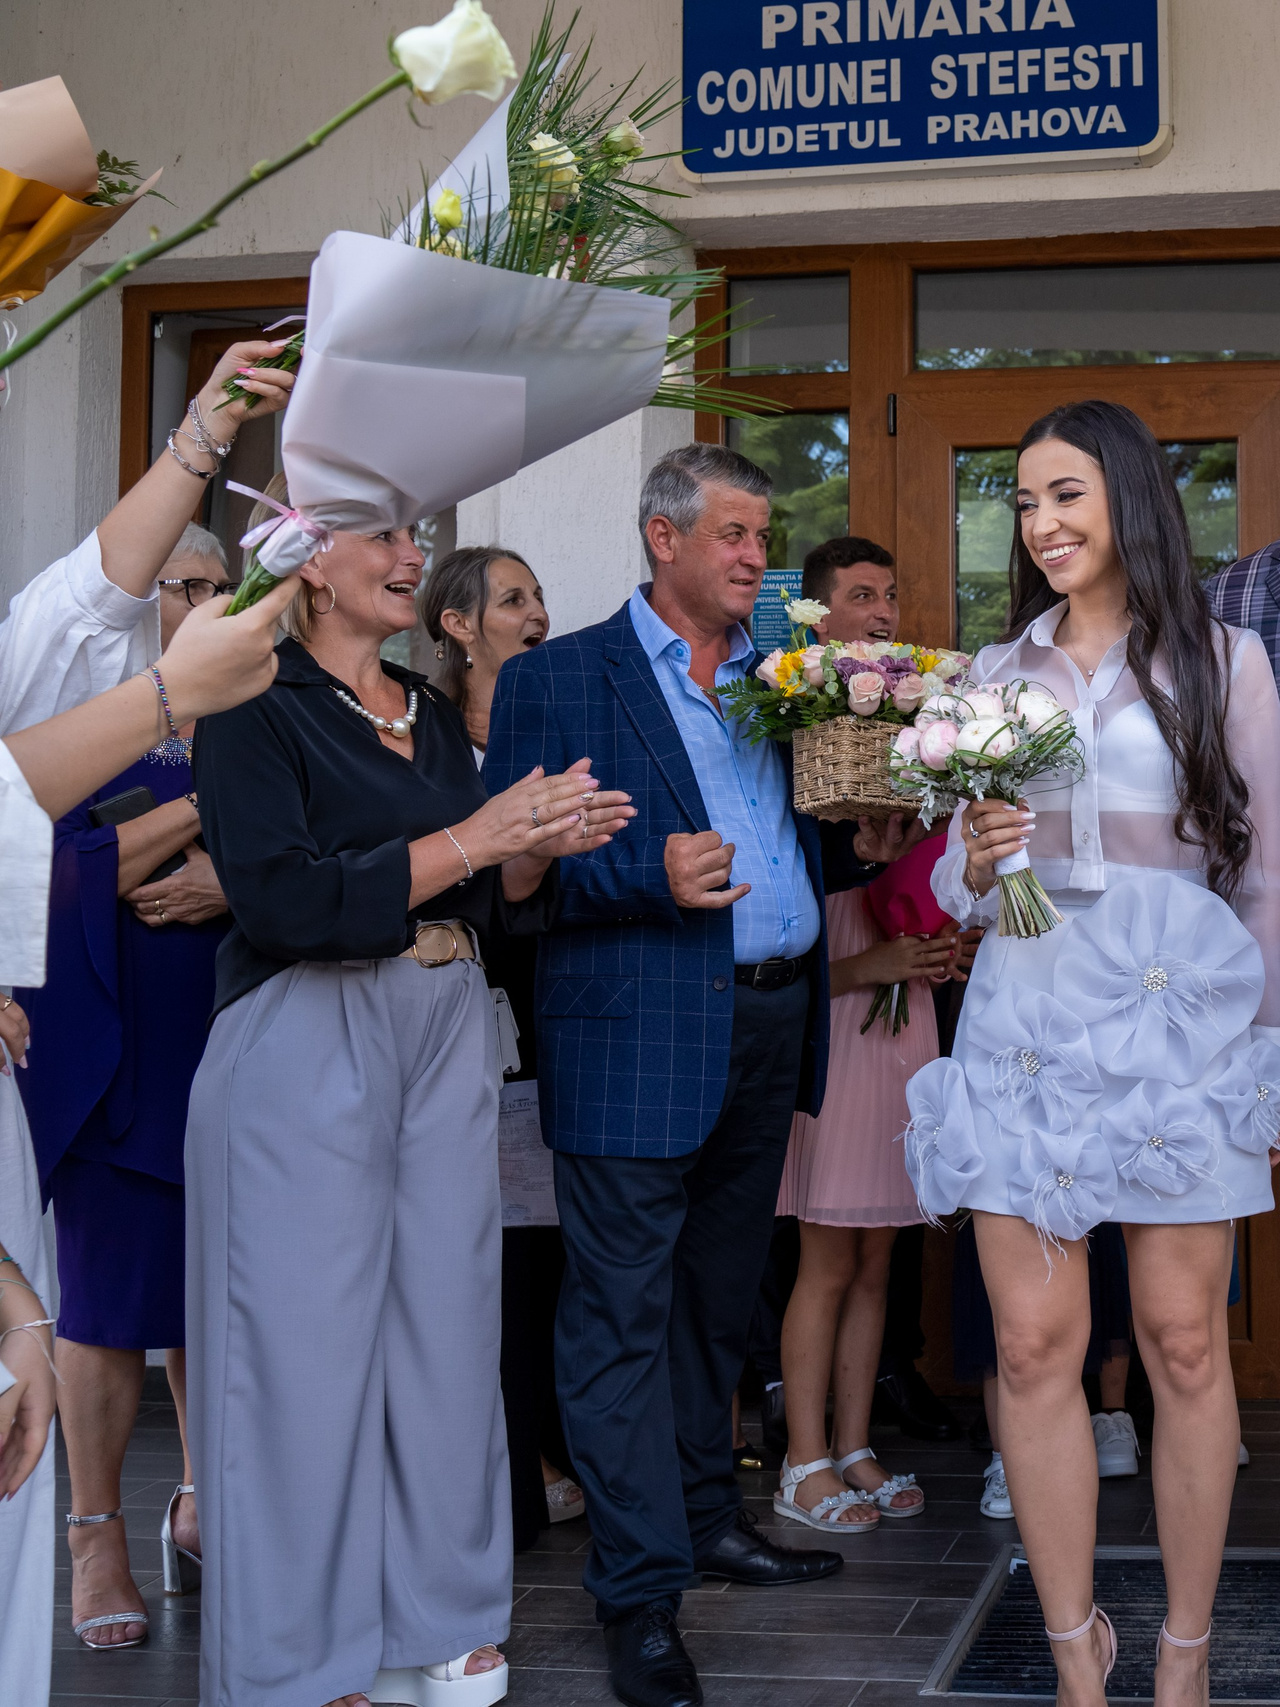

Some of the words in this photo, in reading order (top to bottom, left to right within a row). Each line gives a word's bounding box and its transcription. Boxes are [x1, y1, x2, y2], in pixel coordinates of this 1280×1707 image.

[762, 0, 1075, 49] PRIMARIA
[697, 58, 901, 115] COMUNEI
[930, 43, 1144, 99] STEFESTI
[712, 119, 901, 158] JUDETUL
[928, 105, 1127, 144] PRAHOVA
